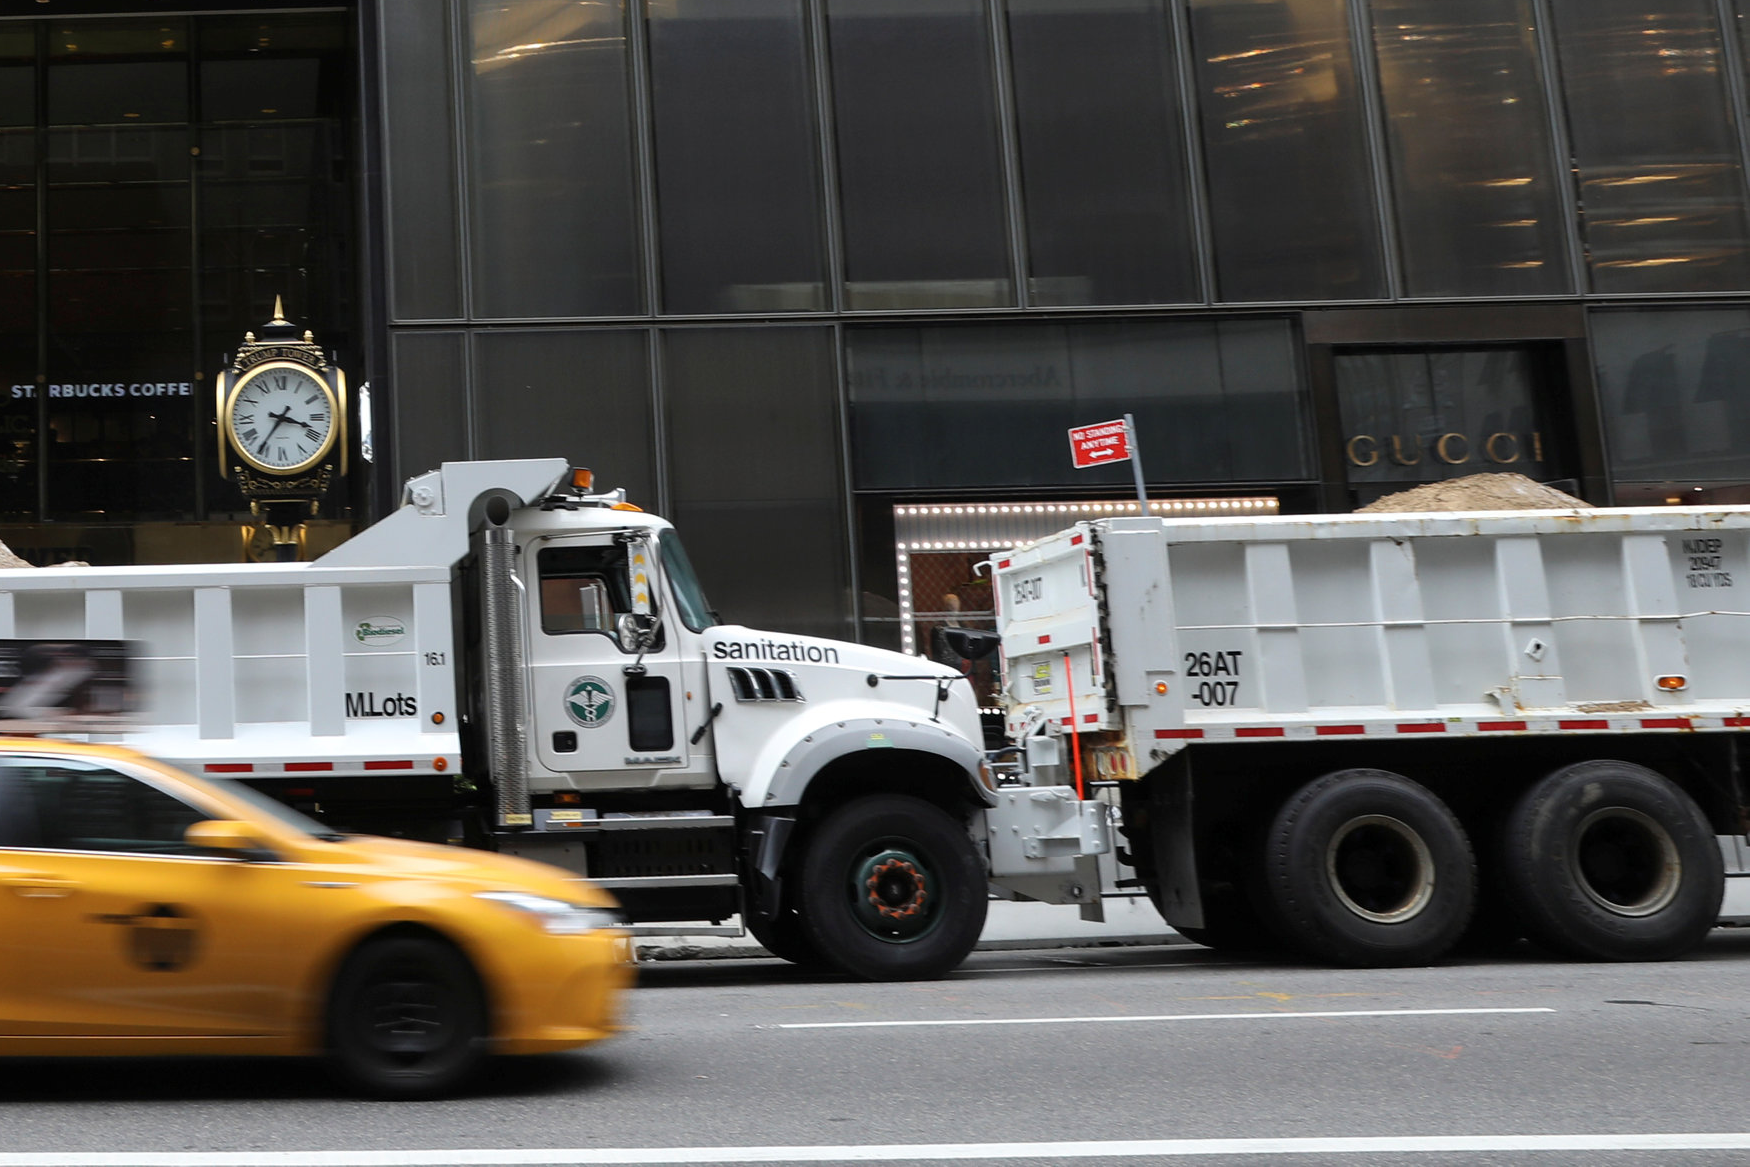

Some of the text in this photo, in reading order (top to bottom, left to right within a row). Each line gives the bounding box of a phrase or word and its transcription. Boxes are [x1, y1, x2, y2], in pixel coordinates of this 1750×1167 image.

[243, 348, 316, 366] TRUMP TOWER
[11, 383, 194, 398] STRBUCKS COFFE
[1073, 424, 1124, 441] NO STANDING
[1081, 436, 1120, 450] ANYTIME
[1347, 432, 1544, 467] GUCCI
[424, 652, 446, 666] 16.1
[714, 638, 839, 664] sanitation
[1185, 651, 1243, 677] 26AT
[346, 692, 417, 717] M.Lots
[1191, 681, 1239, 707] -007
